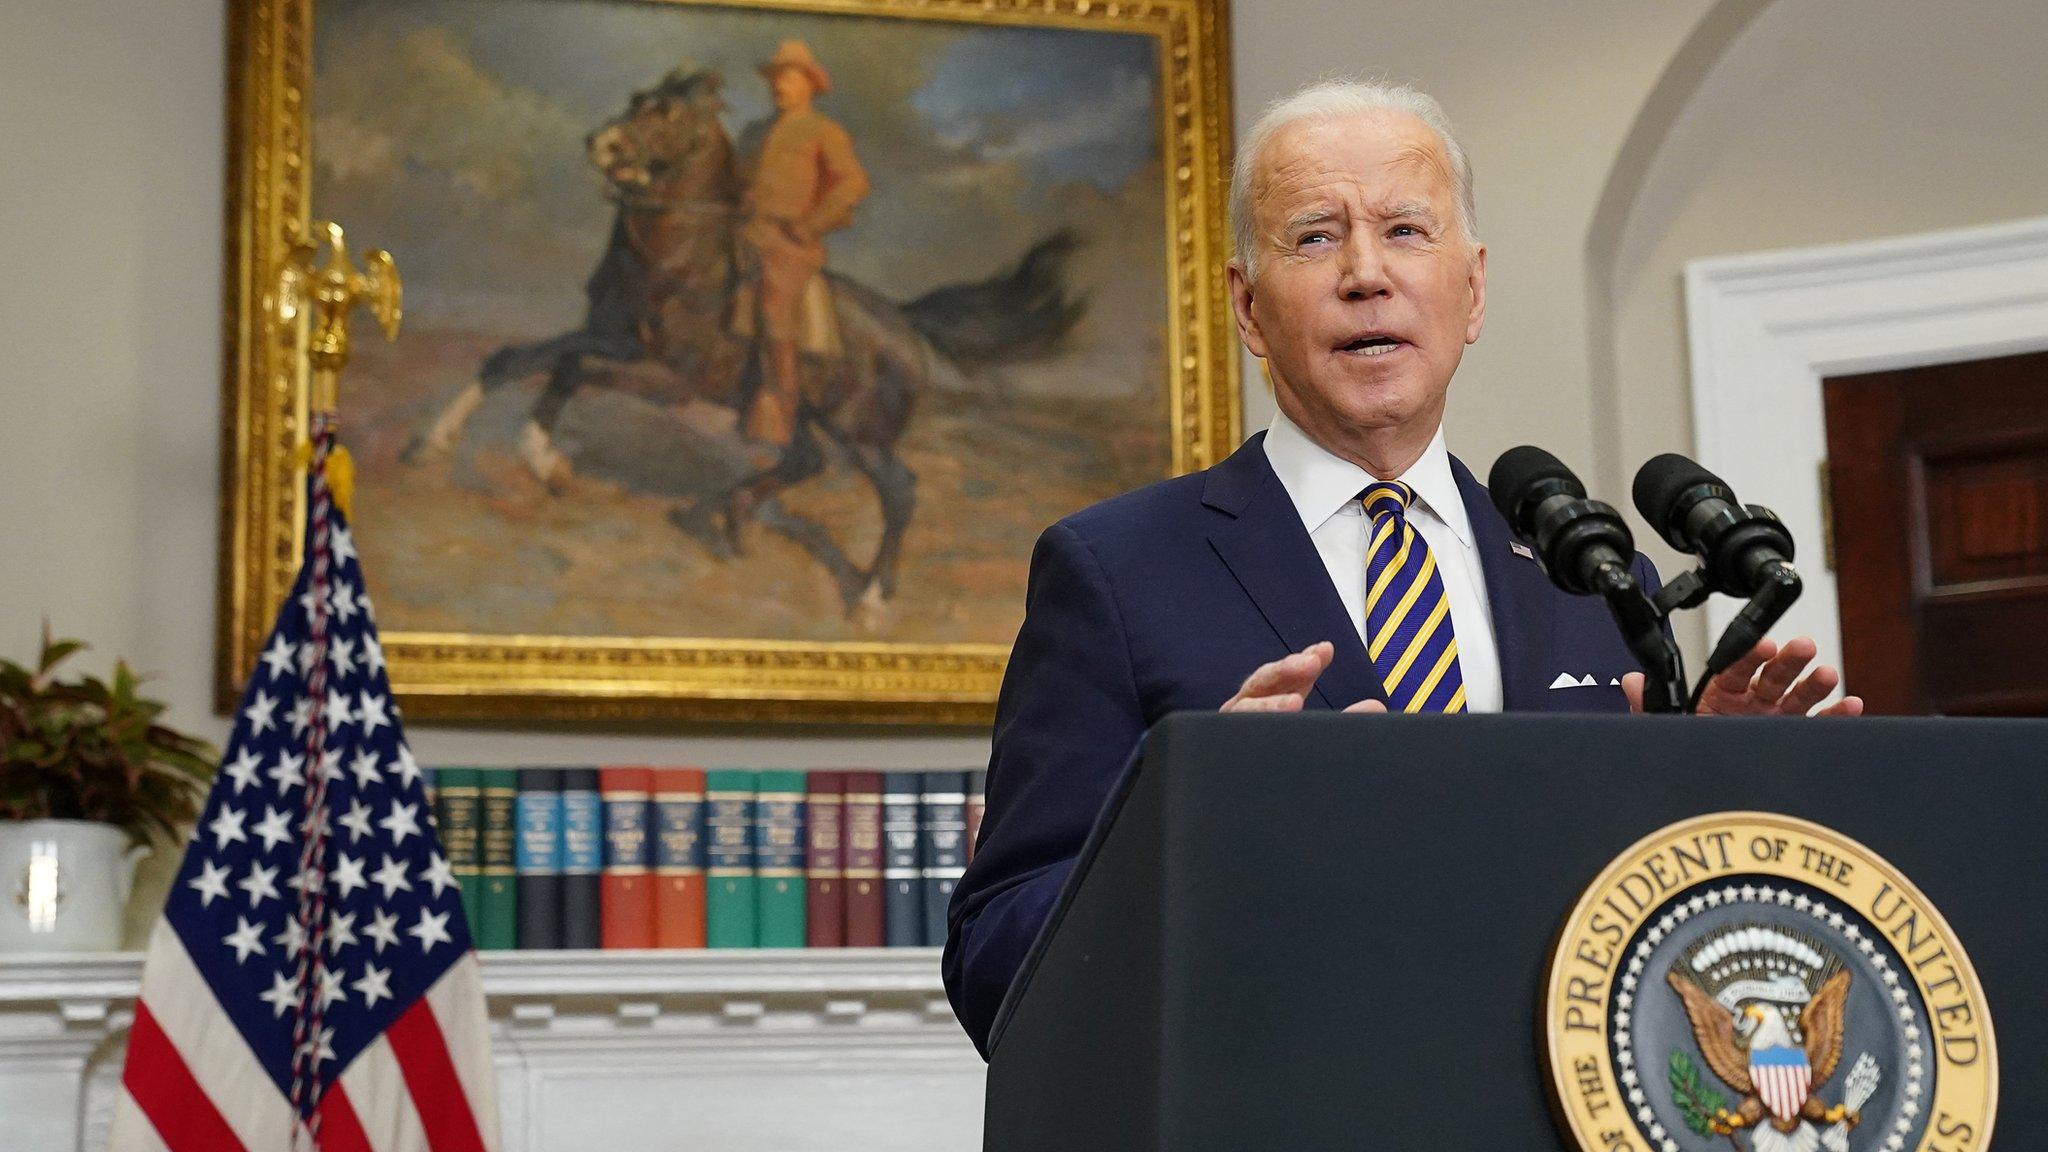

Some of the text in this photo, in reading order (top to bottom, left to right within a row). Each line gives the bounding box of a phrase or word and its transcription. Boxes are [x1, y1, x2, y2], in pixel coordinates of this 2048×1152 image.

[1751, 837, 1788, 861] OF
[1799, 845, 1853, 886] THE
[1566, 832, 1734, 1033] PRESIDENT
[1872, 883, 1978, 1066] UNITED
[1574, 1055, 1610, 1119] THE
